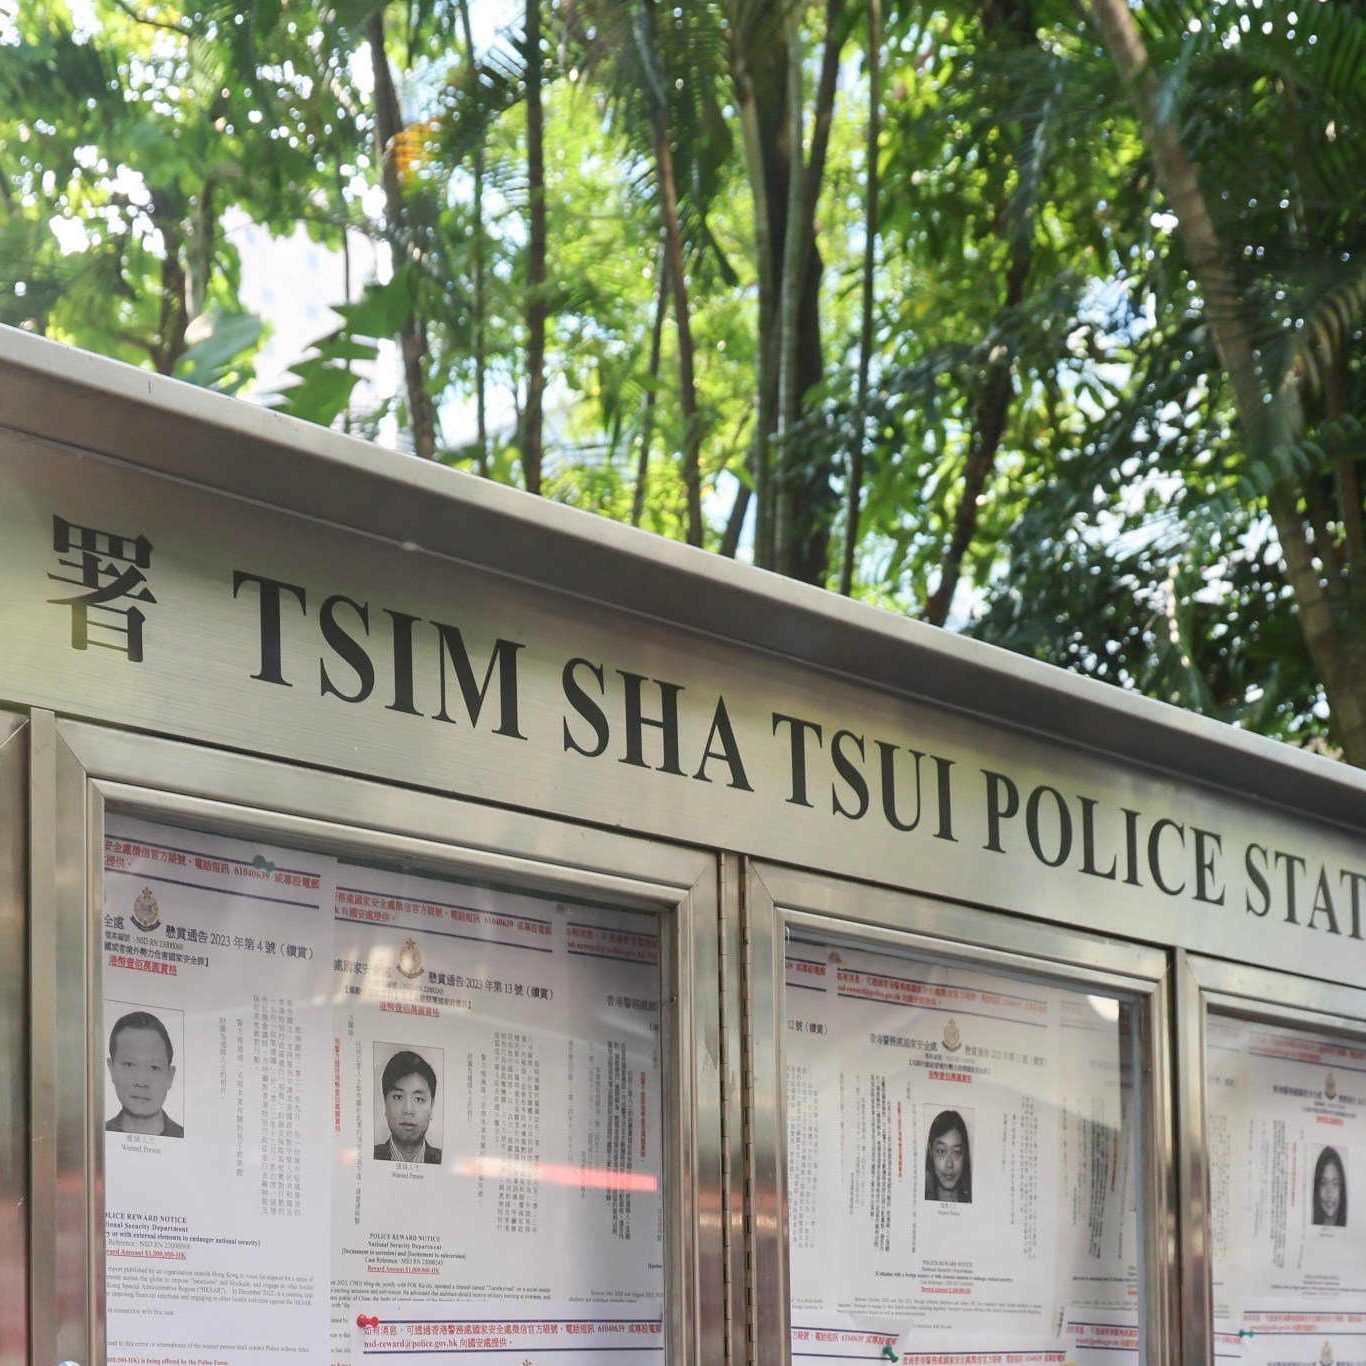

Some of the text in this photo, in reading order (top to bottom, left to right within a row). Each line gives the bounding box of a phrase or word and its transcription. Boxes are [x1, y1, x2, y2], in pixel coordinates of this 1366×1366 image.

[233, 570, 527, 740] TSIM
[562, 656, 755, 792] SHA
[771, 712, 956, 830] TSUI
[982, 772, 1226, 908] POLICE
[166, 924, 208, 945] 懸賞通告
[211, 933, 230, 946] 2023
[234, 936, 254, 951] 年第
[257, 940, 262, 950] 4
[109, 955, 177, 976] 港幣壹佰萬圓賞格
[466, 977, 483, 990] 2023
[485, 980, 502, 994] 年第
[504, 983, 512, 994] 13
[598, 1325, 624, 1334] 61040639
[364, 1338, 457, 1349] nsd-reward@police.gov.hk
